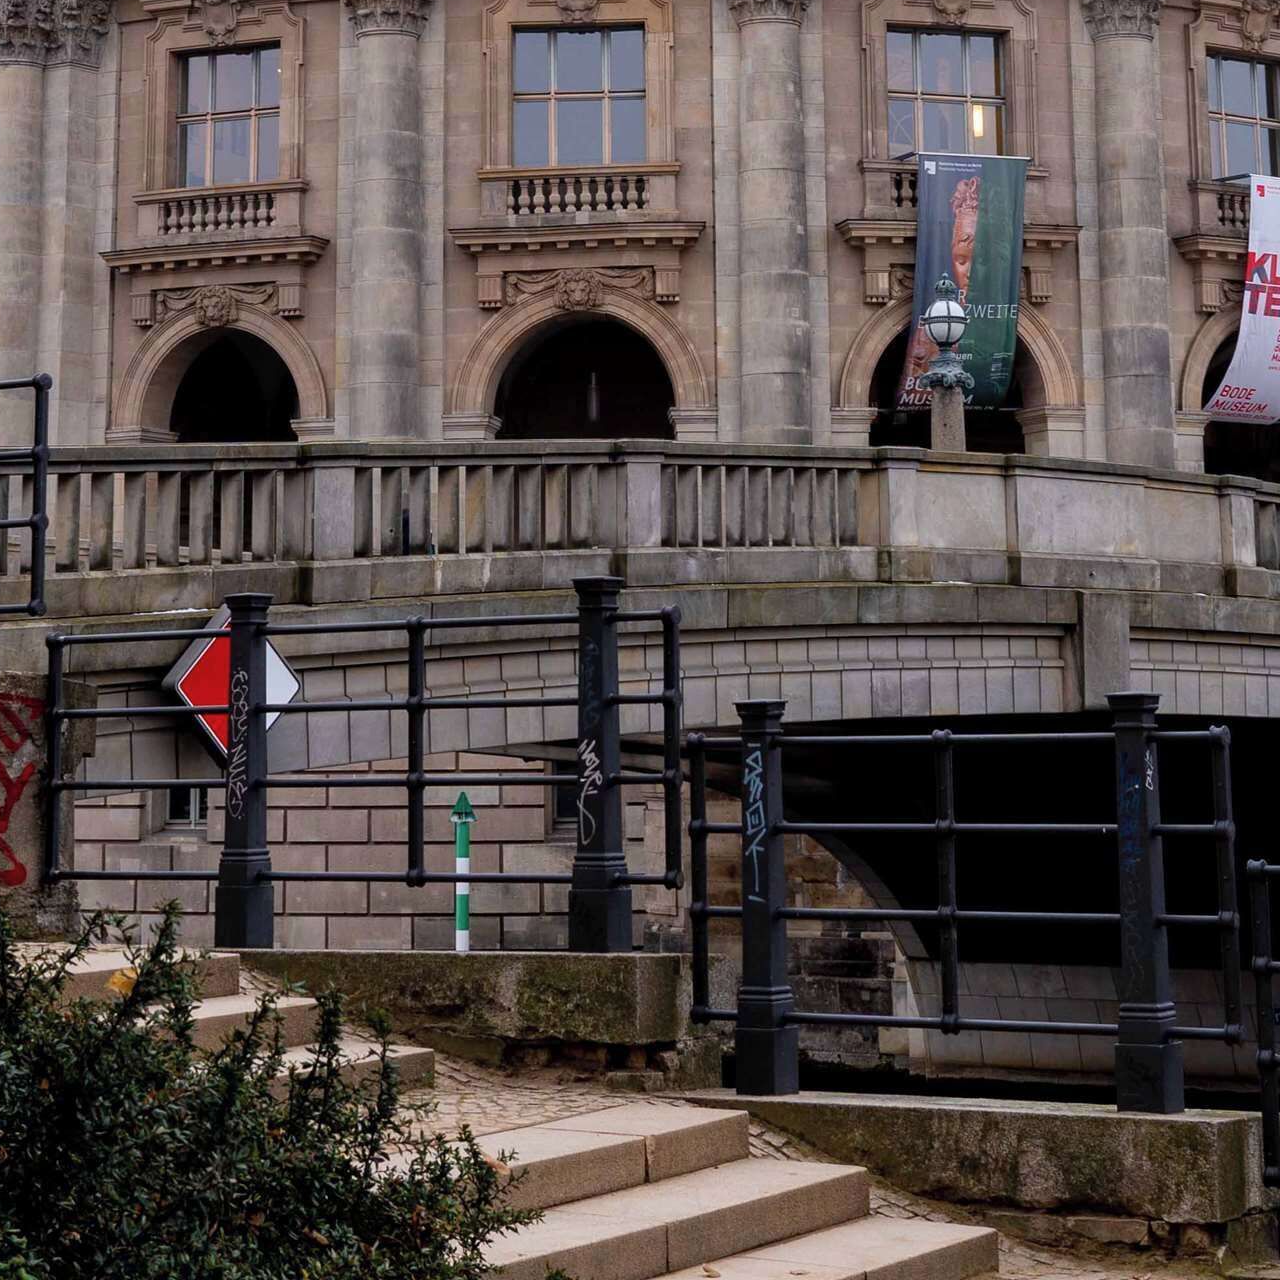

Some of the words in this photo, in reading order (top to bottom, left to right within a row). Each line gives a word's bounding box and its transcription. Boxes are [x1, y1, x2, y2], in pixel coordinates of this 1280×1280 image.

[964, 303, 1018, 319] ZWEITE
[1220, 384, 1257, 401] BODE
[1210, 399, 1269, 414] MUSEUM
